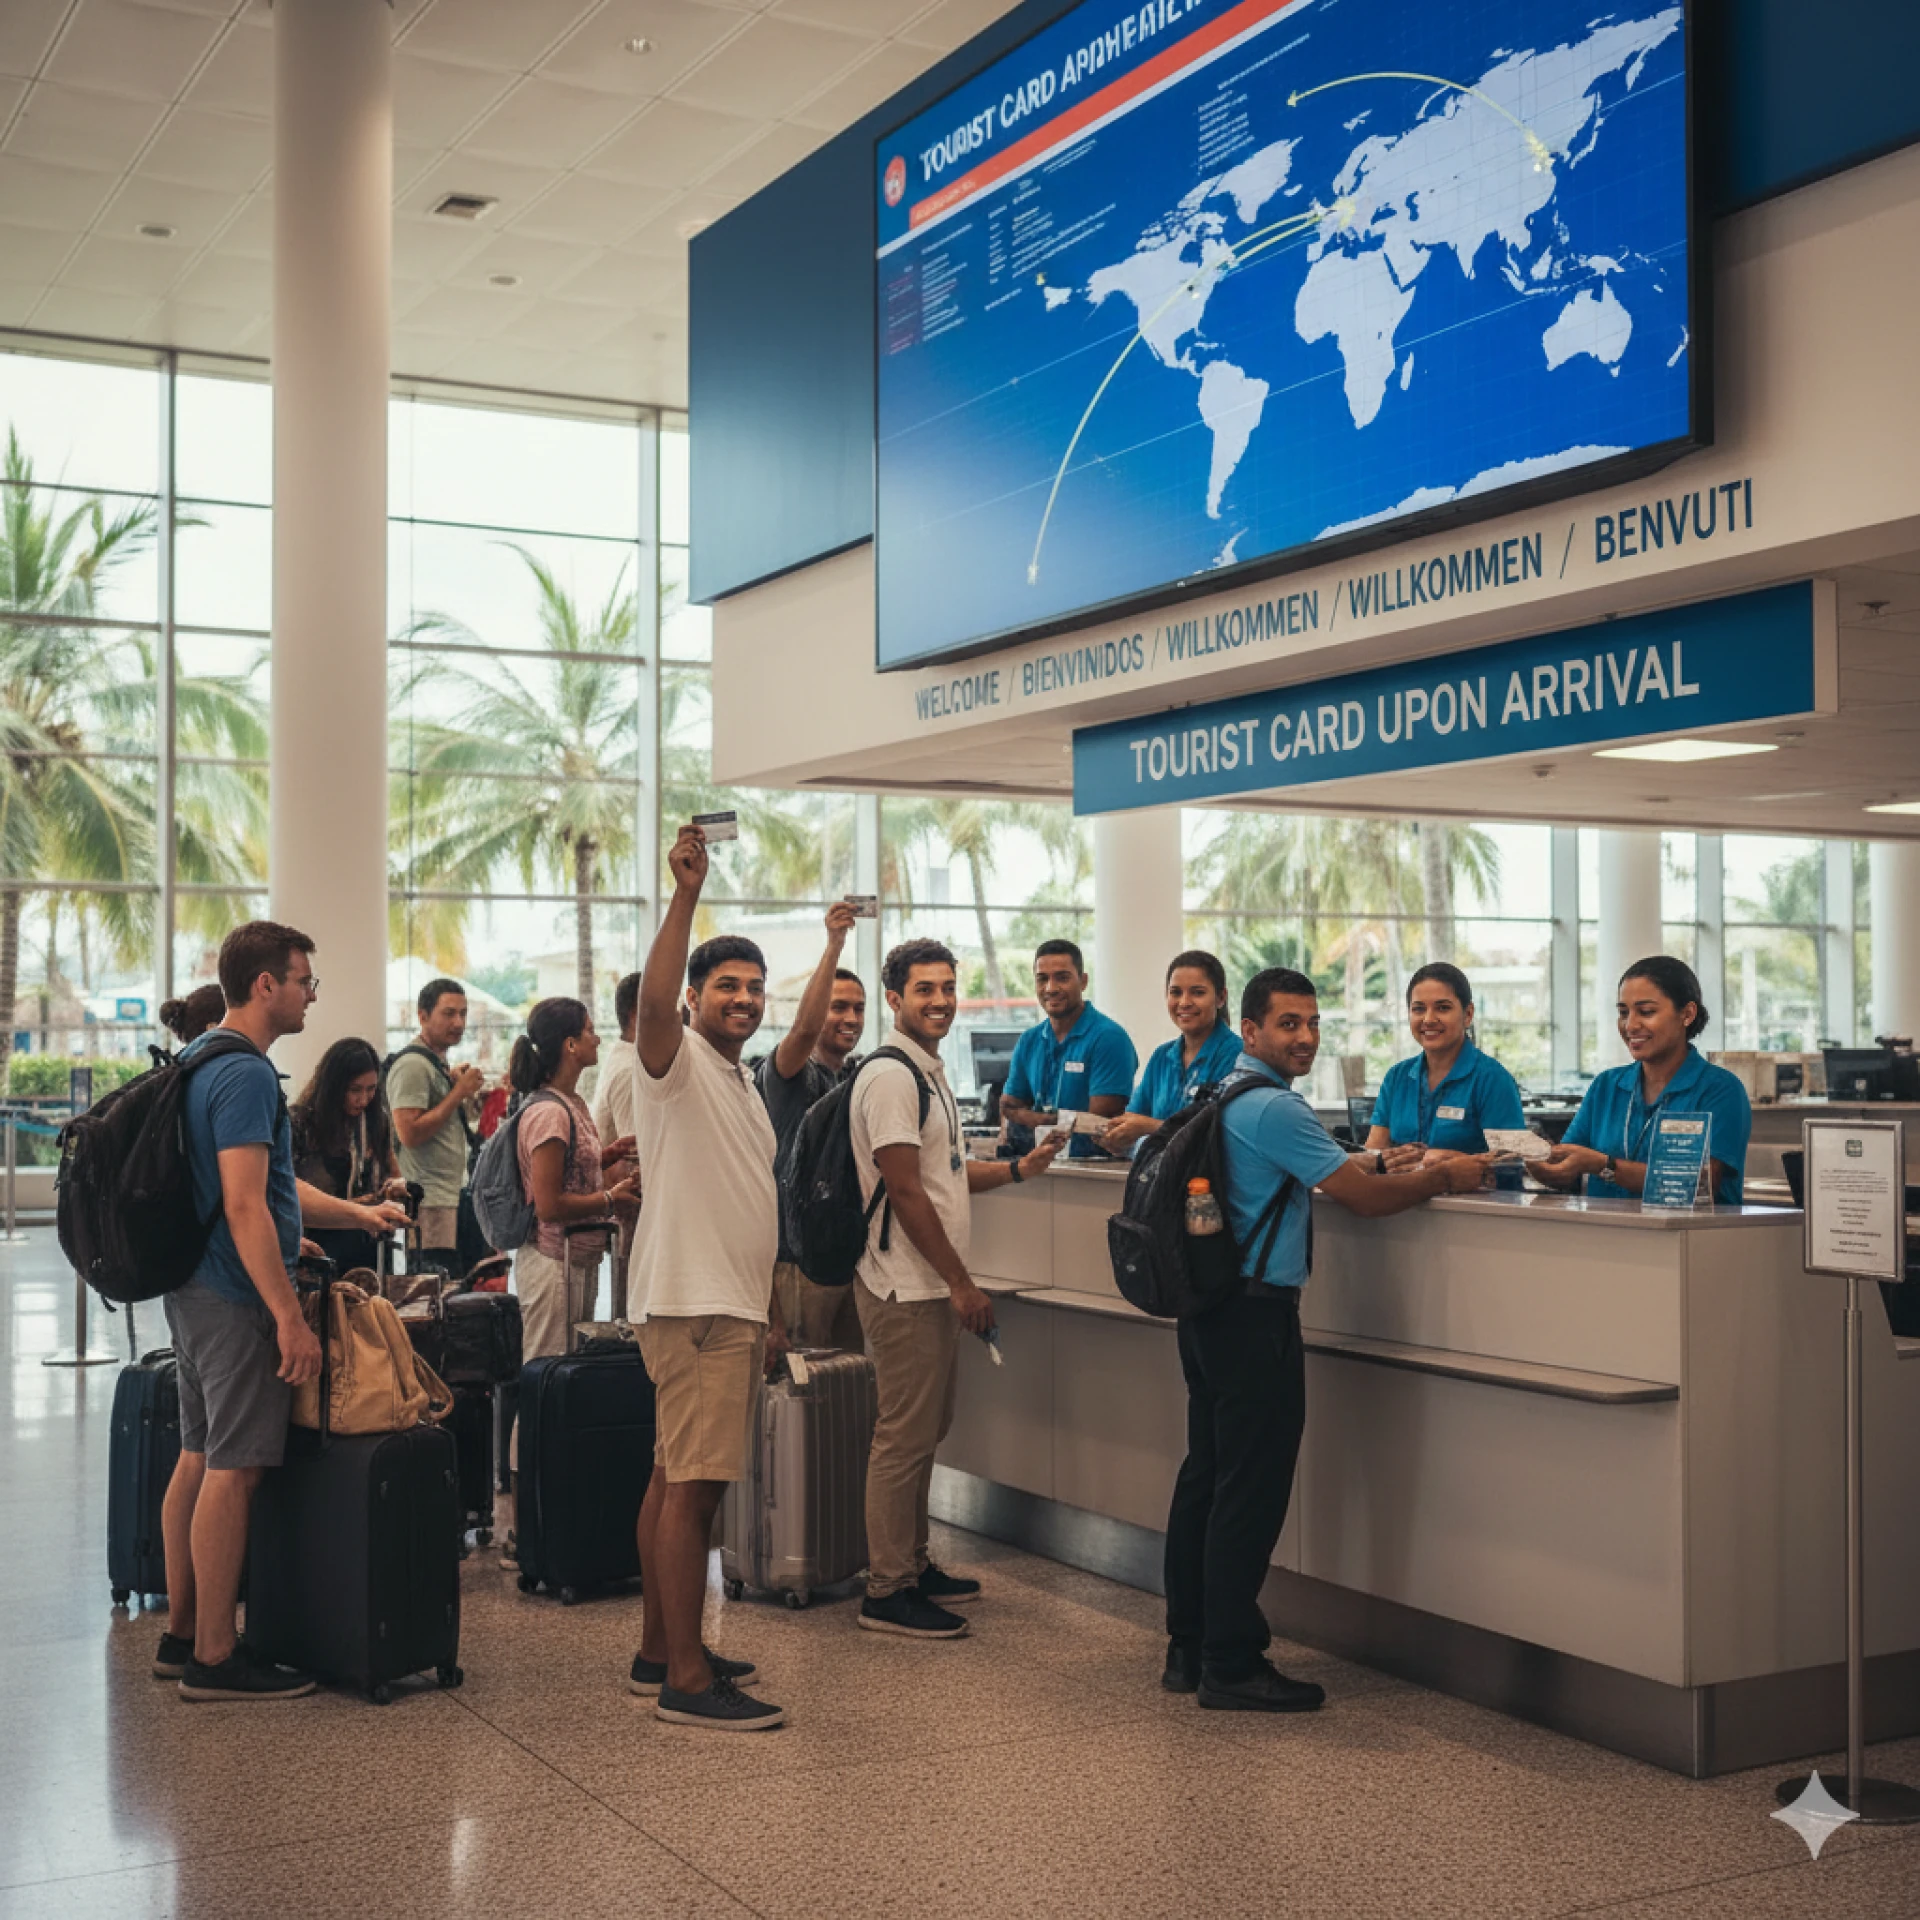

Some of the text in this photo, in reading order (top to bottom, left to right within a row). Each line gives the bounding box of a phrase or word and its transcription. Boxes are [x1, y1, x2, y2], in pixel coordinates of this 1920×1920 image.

[1000, 69, 1055, 128] CARD
[915, 670, 1000, 720] WELCOME
[1023, 633, 1144, 696] BIENVINIDOS
[1166, 590, 1319, 662] WILLKOMMEN
[1348, 532, 1543, 620] WILLKOMMEN
[1595, 478, 1753, 564] BENVUTI
[1130, 640, 1700, 784] TOURIST CARD UPON ARRIVAL
